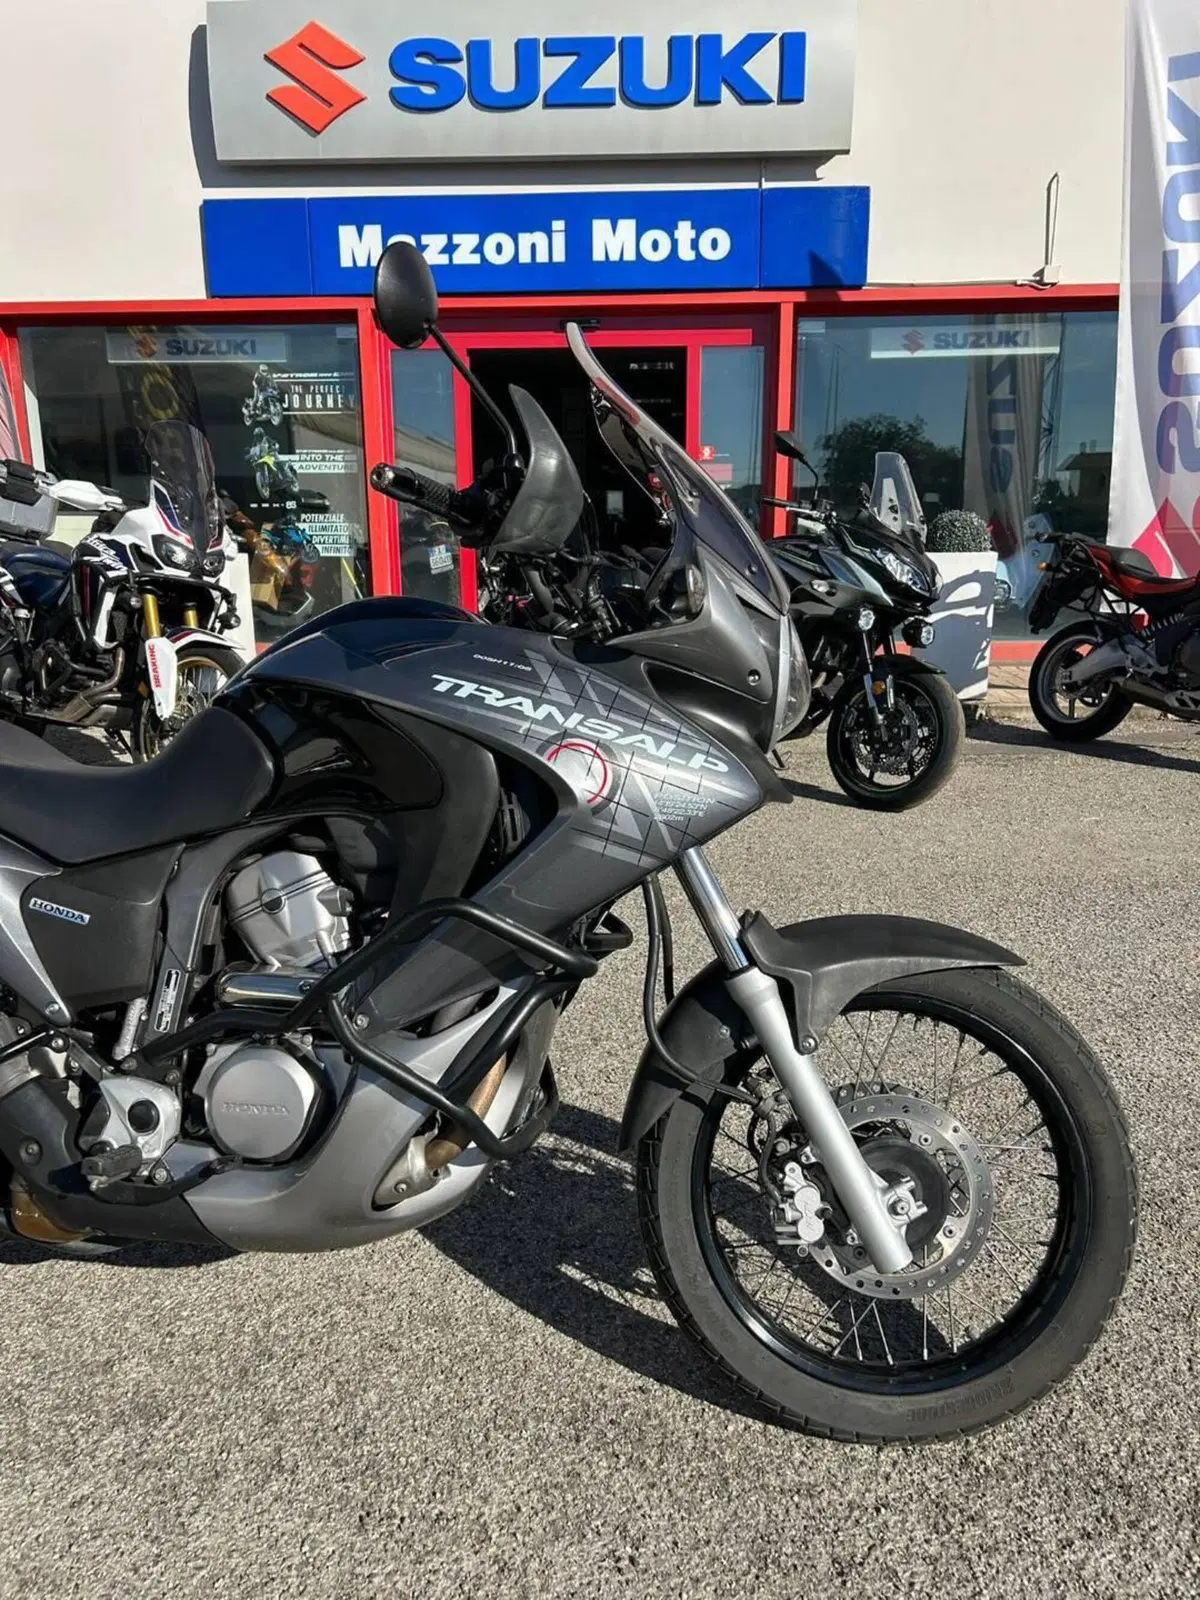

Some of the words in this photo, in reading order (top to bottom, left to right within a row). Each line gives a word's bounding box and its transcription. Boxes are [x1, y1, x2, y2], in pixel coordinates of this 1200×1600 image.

[389, 31, 806, 113] SUZUKI
[338, 219, 566, 268] Mzzoni
[592, 218, 732, 261] Moto
[166, 338, 257, 356] SUZUKI
[933, 330, 1030, 349] SUZUKI
[291, 385, 303, 393] THE
[282, 394, 355, 408] JOURNEY
[300, 513, 344, 522] POTENZIALE
[308, 524, 349, 533] ILLIMITATO
[148, 643, 162, 689] BRAKING
[431, 673, 729, 774] TRANSALP
[32, 899, 87, 923] HONDA
[222, 1102, 290, 1117] HONDA
